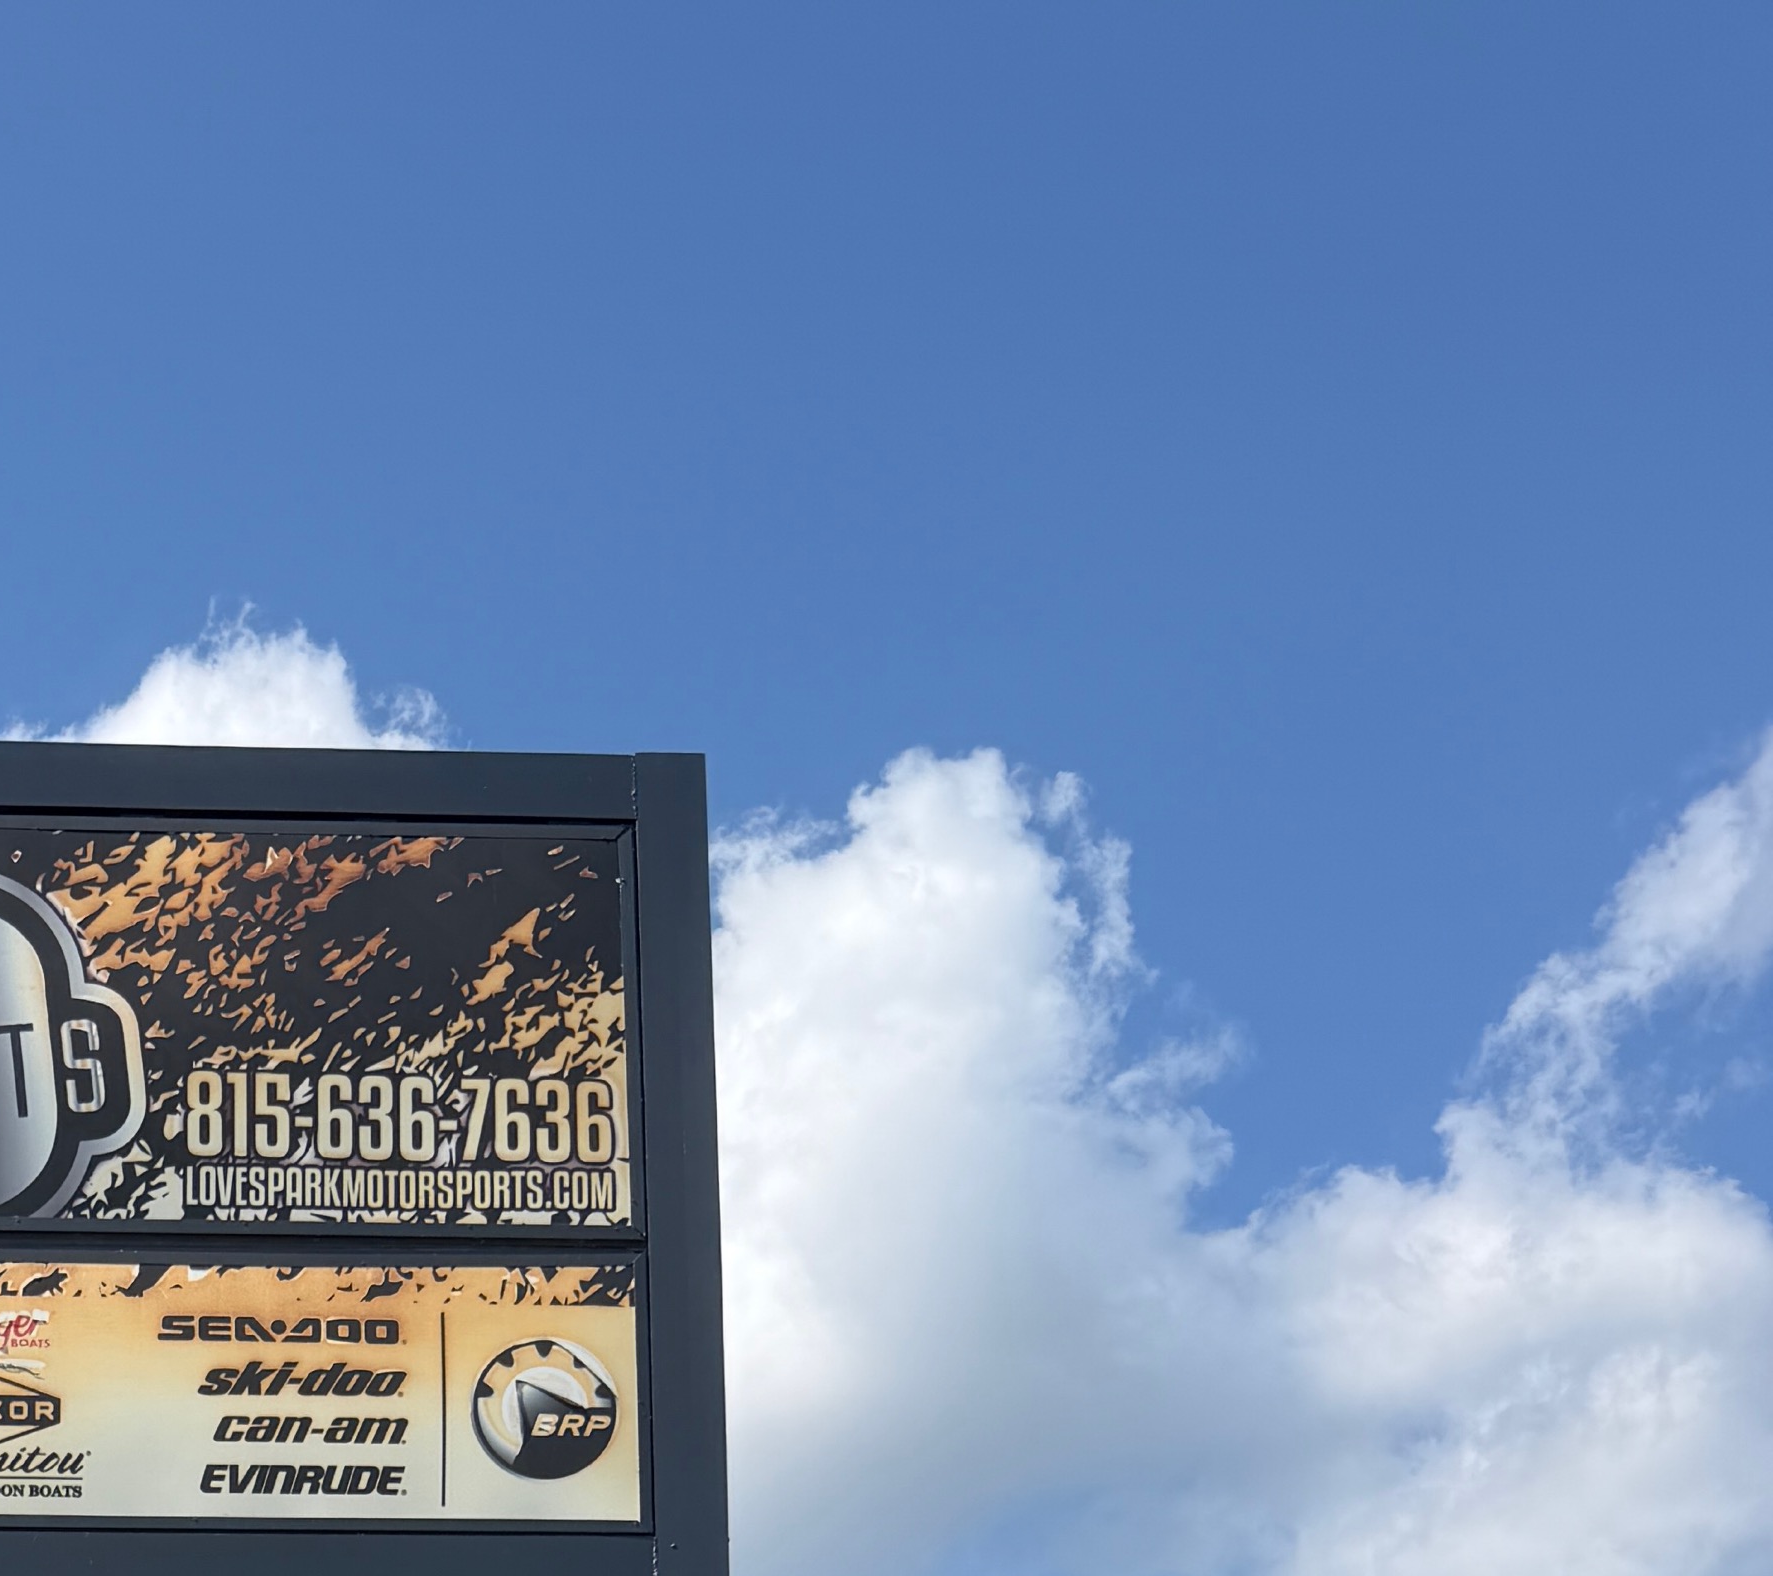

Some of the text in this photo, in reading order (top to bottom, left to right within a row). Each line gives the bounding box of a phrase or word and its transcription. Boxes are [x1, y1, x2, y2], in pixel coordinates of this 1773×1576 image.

[185, 1069, 617, 1163] 815-636-7636
[184, 1164, 615, 1211] LOVESPARKMOTORSPORTS.COM
[11, 1338, 51, 1348] BOATS
[197, 1361, 408, 1397] ski-doo
[213, 1415, 403, 1445] can-am
[531, 1412, 613, 1439] BRP
[29, 1484, 83, 1498] BOATS
[200, 1464, 402, 1495] EVINRUDE
